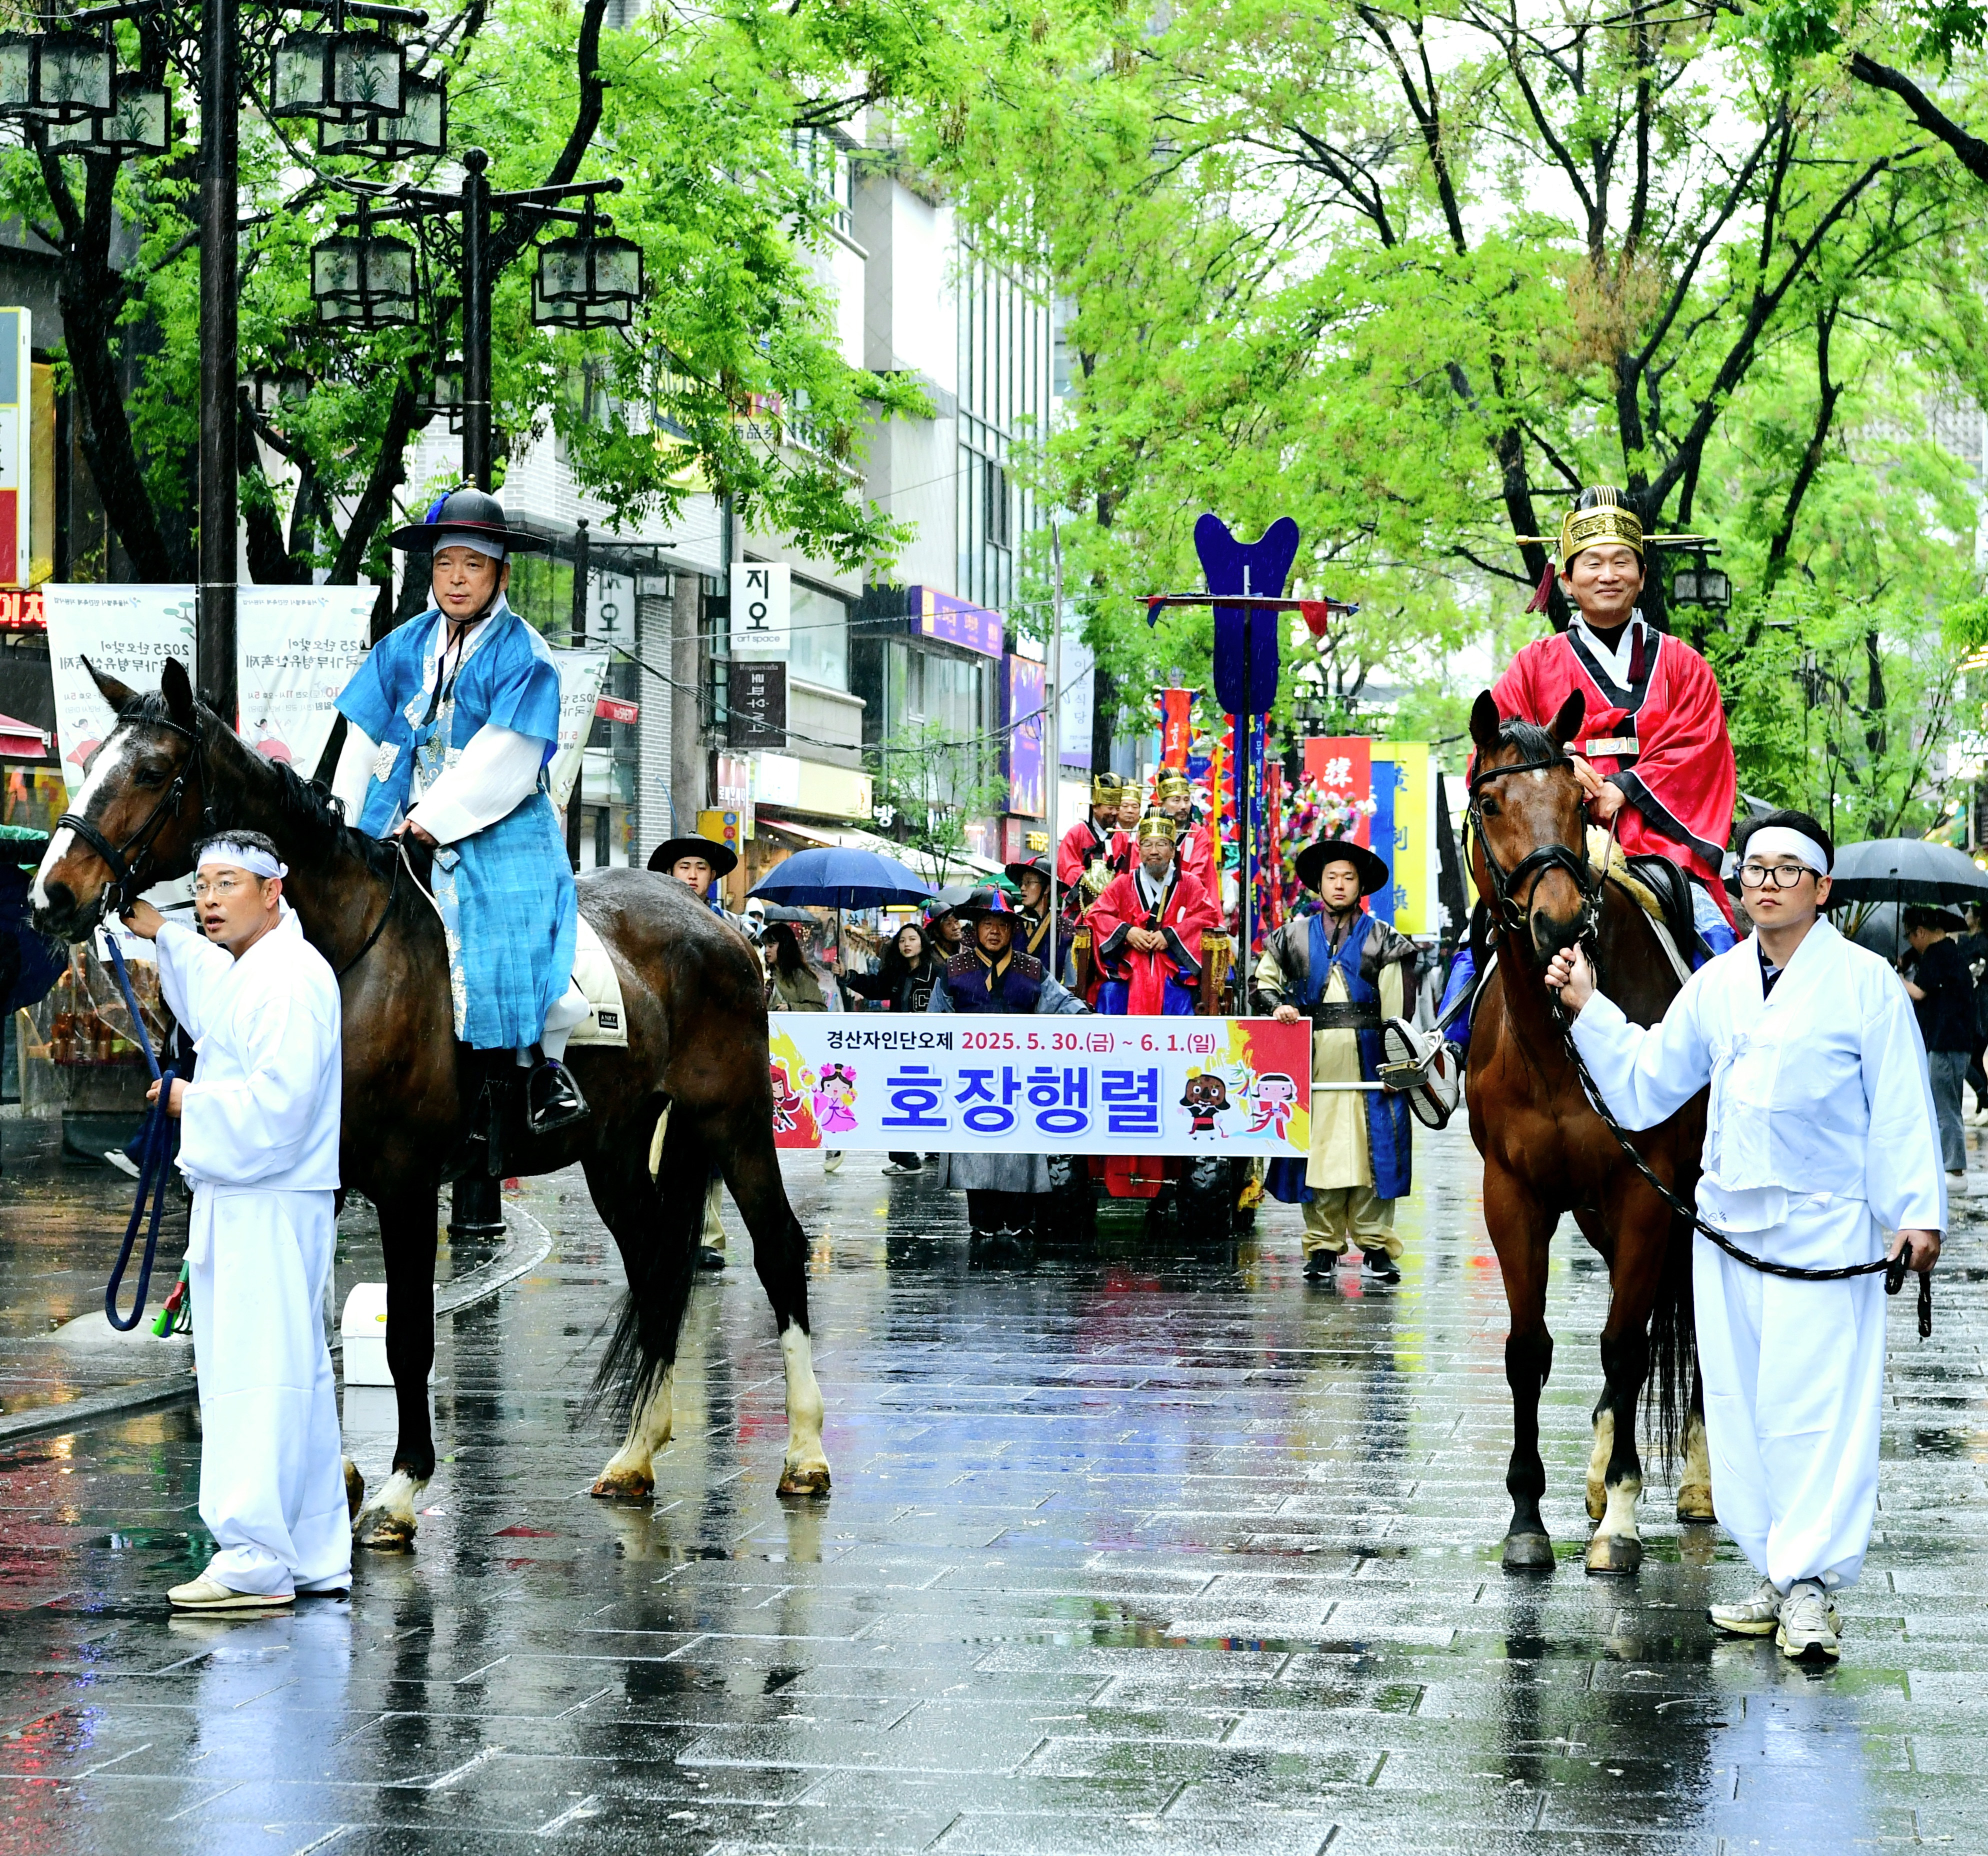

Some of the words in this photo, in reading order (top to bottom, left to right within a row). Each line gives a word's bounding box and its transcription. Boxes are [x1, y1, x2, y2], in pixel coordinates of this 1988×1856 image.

[737, 634, 752, 642] art
[752, 635, 780, 644] space
[826, 1030, 954, 1050] 경산자인단오제
[962, 1032, 1021, 1050] 2025.
[1026, 1032, 1045, 1050] 5.
[1052, 1032, 1114, 1053] 30.(금)
[1140, 1034, 1160, 1052] 6.
[1166, 1033, 1216, 1054] 1.(일)
[880, 1064, 1159, 1132] 호장행렬
